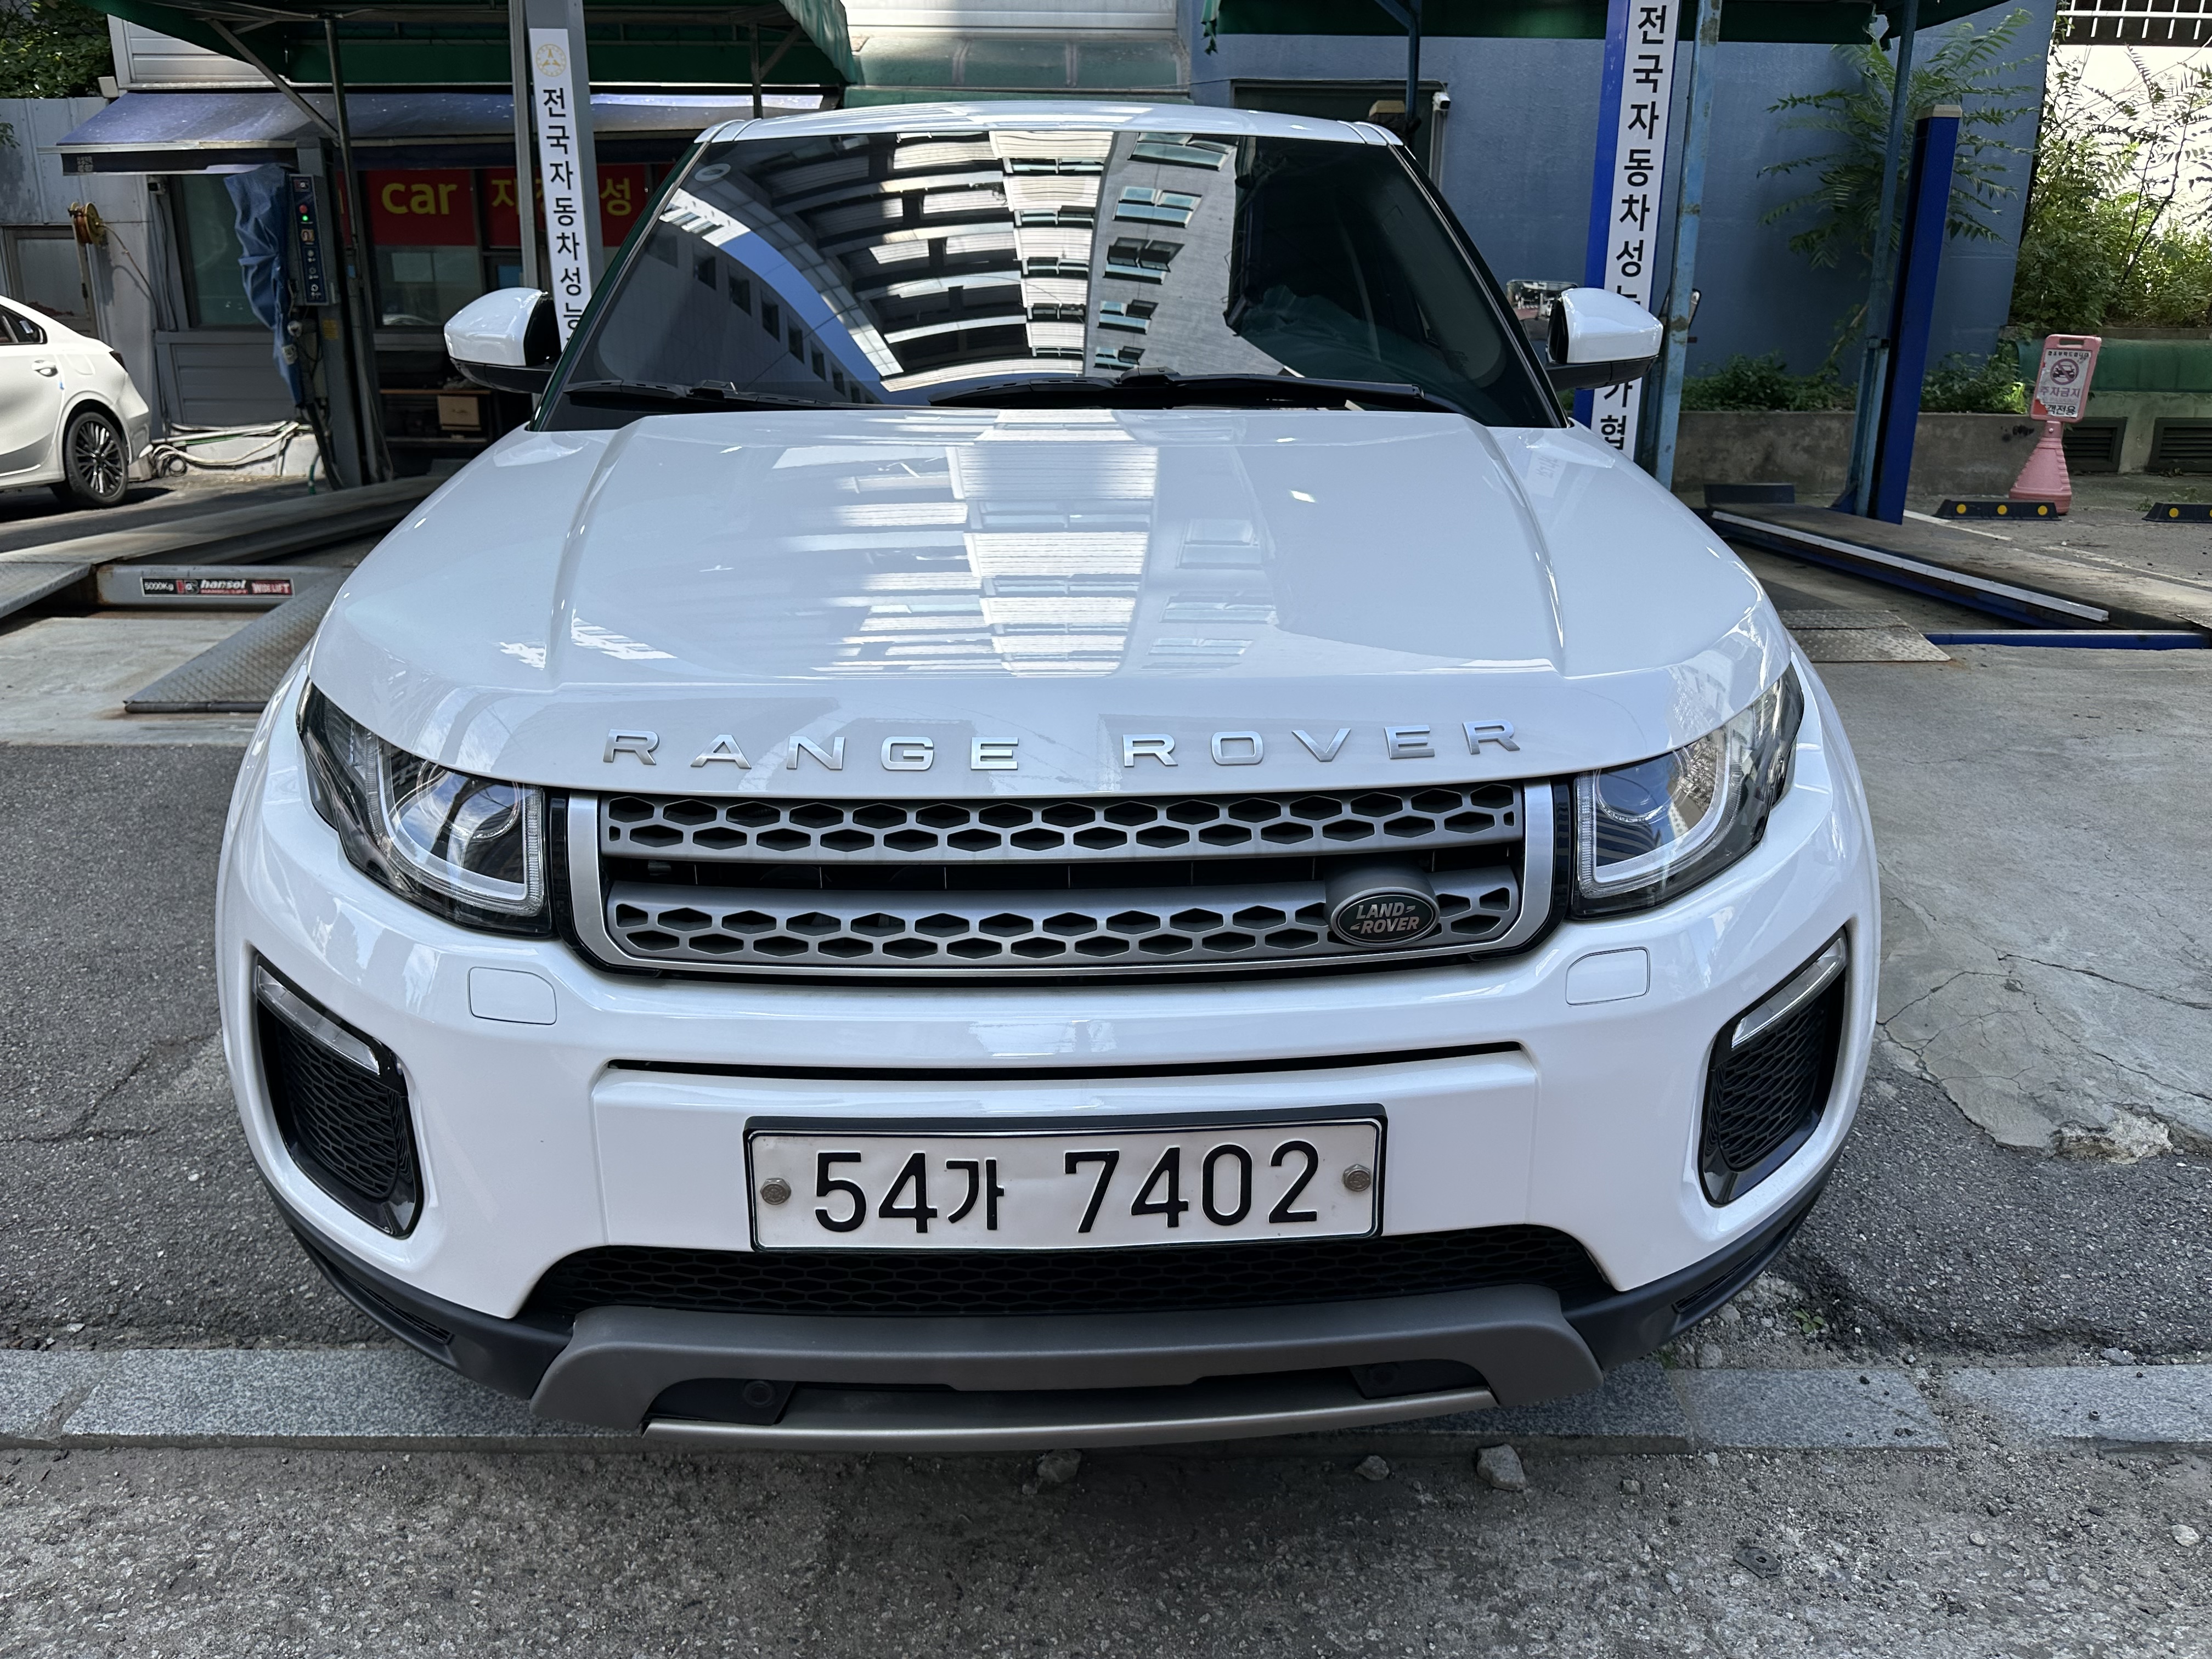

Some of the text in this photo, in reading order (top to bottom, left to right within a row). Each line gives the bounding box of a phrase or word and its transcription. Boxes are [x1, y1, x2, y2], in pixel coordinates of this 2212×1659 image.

[381, 182, 458, 215] car
[543, 87, 582, 341] 전국자동차성능
[2046, 405, 2076, 416] 객전용
[200, 580, 247, 589] hansol
[603, 719, 1520, 771] RANGE ROVER
[1356, 902, 1404, 919] LAND
[1360, 916, 1420, 934] ROVER
[815, 1139, 1318, 1234] 54가 7402
